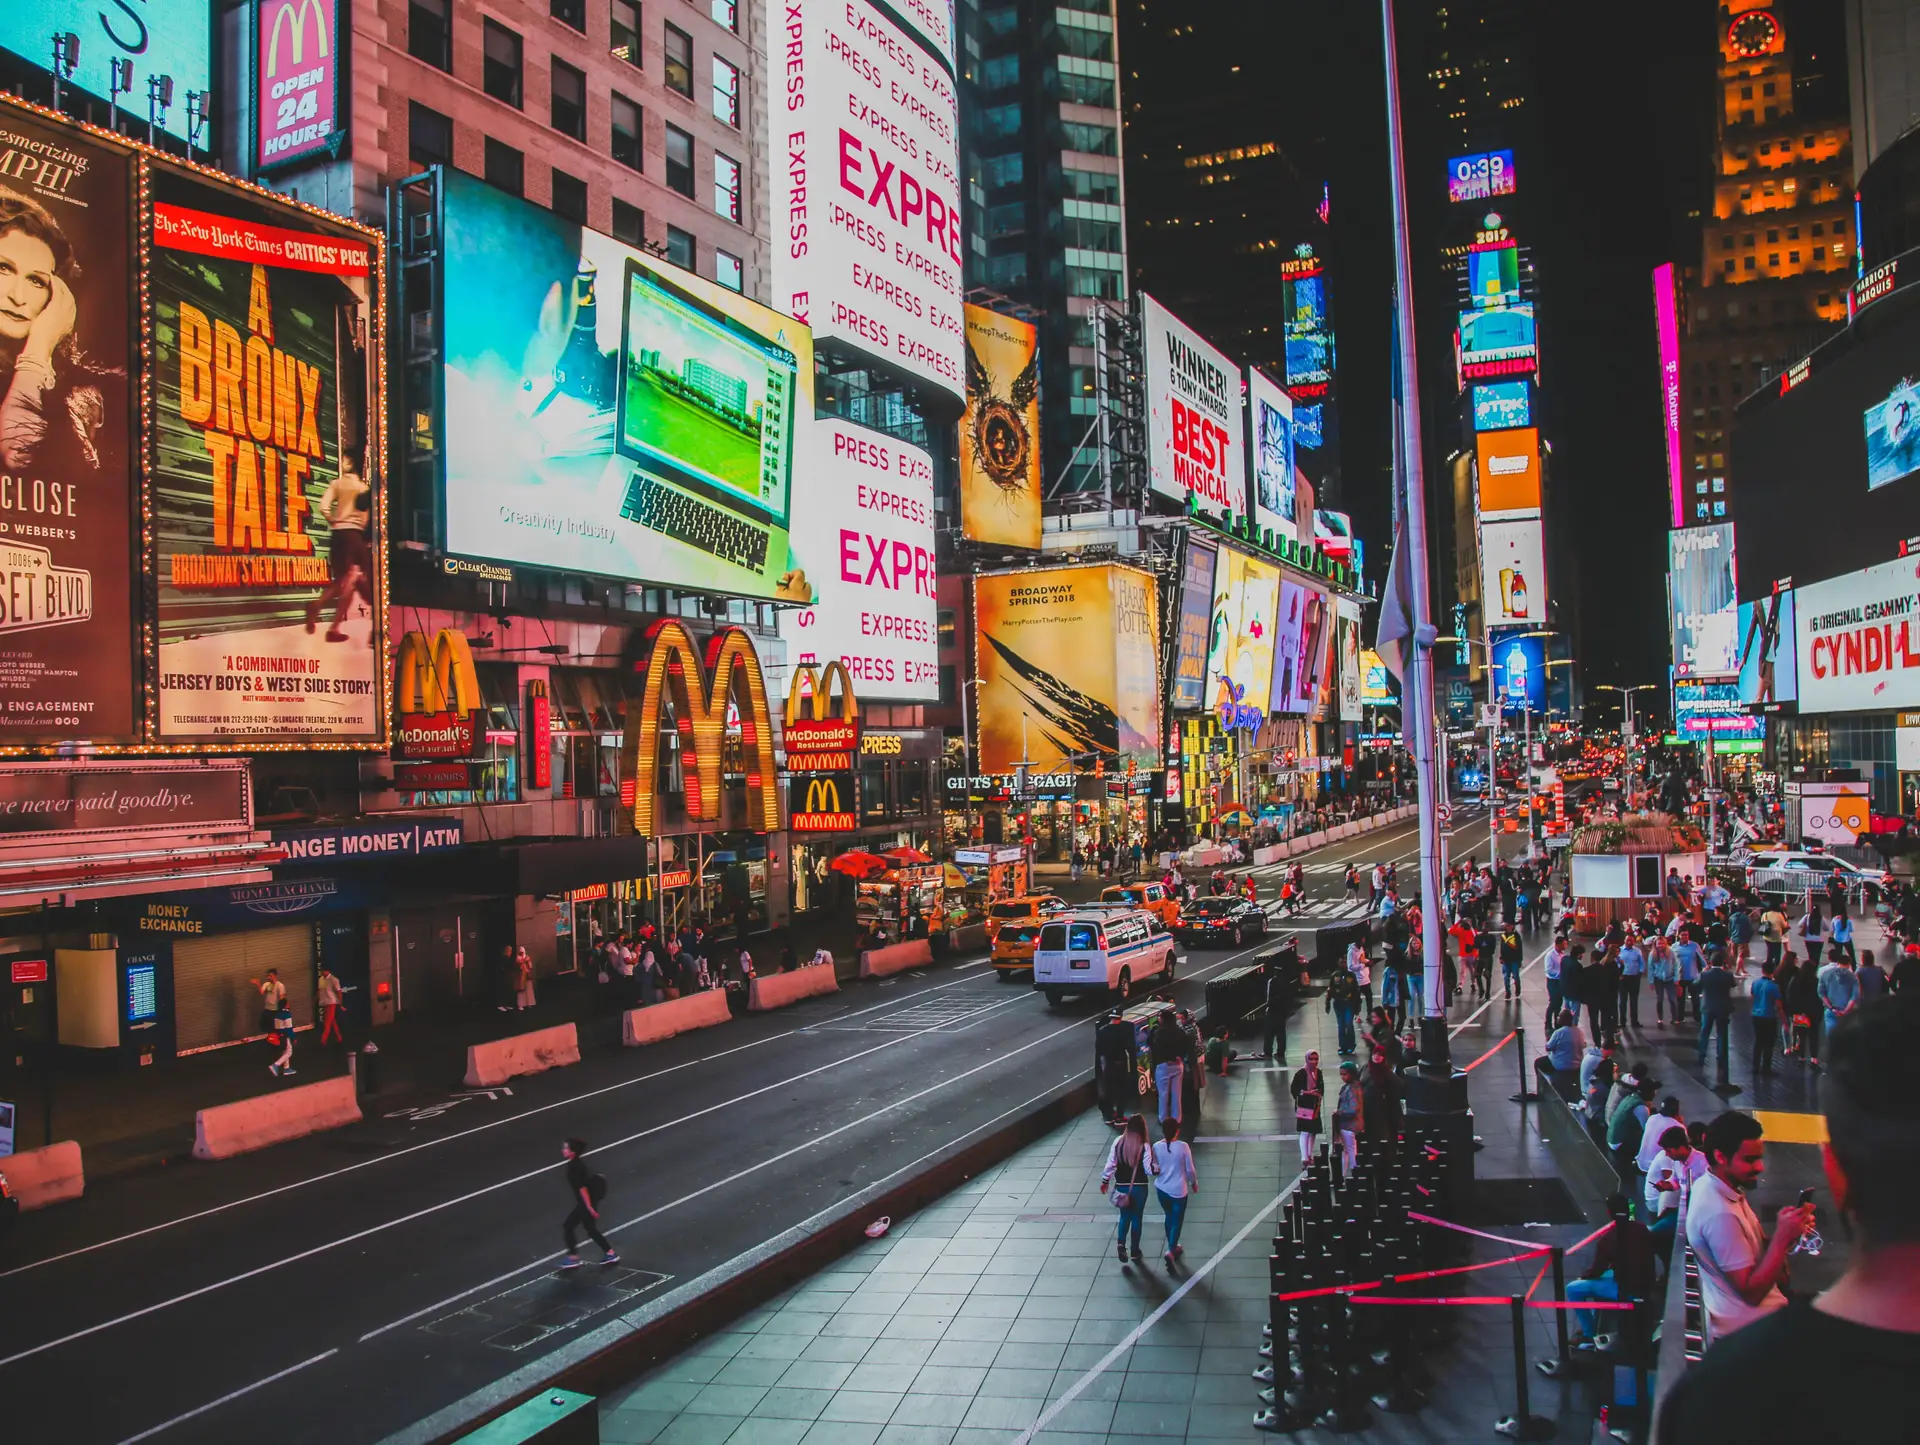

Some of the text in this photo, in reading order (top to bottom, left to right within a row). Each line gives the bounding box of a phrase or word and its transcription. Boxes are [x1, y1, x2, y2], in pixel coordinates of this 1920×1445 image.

[847, 2, 915, 75] EXPRESS
[785, 0, 804, 111] XPRESS
[271, 67, 324, 100] OPEN
[276, 90, 318, 130] 24
[849, 93, 917, 159] EXPRESS
[891, 80, 950, 145] EXPRESS
[264, 118, 331, 157] HOURS
[1458, 156, 1504, 181] 0:39
[788, 131, 807, 259] EXPRESS
[154, 211, 178, 234] The
[181, 219, 209, 241] New
[211, 226, 243, 248] York
[244, 232, 283, 256] Times
[340, 249, 369, 267] PICK
[1469, 239, 1517, 252] TOSHIBA
[895, 241, 955, 295] EXPRESS
[1856, 260, 1897, 295] MARRIOTT
[248, 263, 273, 344] A
[853, 263, 922, 318] EXPRESS
[1856, 278, 1892, 306] MARQUIS
[968, 321, 1029, 348] #KeepTheSecrets
[898, 333, 958, 382] EXPRESS
[1166, 330, 1228, 403] WINNER!
[1463, 357, 1536, 378] TOSHIBA
[180, 300, 322, 459] BRONX
[1170, 367, 1229, 420] 6 TONY AWARDS
[835, 432, 889, 471] PRESS
[1171, 396, 1230, 477] BEST
[1, 475, 76, 517] CLOSE
[204, 430, 311, 553] TALE
[1173, 452, 1231, 508] MUSICAL
[858, 485, 925, 524] EXPRESS
[14, 524, 76, 540] WEBBER'S
[500, 506, 615, 544] Creativity Industry
[171, 554, 329, 587] BROADWAY'S NEW HIT MUSICAL
[46, 575, 88, 618] BLVD.
[1009, 594, 1075, 607] SPRING 2018
[1010, 585, 1073, 597] BROADWAY
[1118, 579, 1151, 611] HARRY
[861, 612, 928, 642] EXPRESS
[1002, 616, 1083, 627] HarryPotterThePlay.com
[1117, 604, 1154, 638] POTTER
[1820, 607, 1863, 630] ORIGINAL
[236, 656, 306, 673] COMBINATION
[309, 660, 320, 673] OF
[1810, 620, 1920, 680] CYNDI L
[160, 673, 212, 690] JERSEY
[216, 675, 252, 692] BOYS
[254, 677, 264, 692] &
[266, 677, 301, 692] WEST
[304, 678, 330, 694] SIDE
[840, 655, 895, 682] PRESS
[8, 701, 95, 712] ENGAGEMENT
[1219, 676, 1263, 748] Disney
[394, 727, 470, 743] McDonald's
[404, 745, 456, 754] Restaurant
[785, 728, 854, 742] McDonald's
[797, 741, 842, 749] Restaurant
[21, 799, 73, 813] never
[77, 790, 118, 811] said
[119, 789, 194, 814] goodbye.
[280, 829, 460, 859] ANGE MONEY ATM
[140, 917, 203, 933] EXCHANGE
[148, 904, 189, 918] MONEY
[127, 954, 156, 964] CHANGE
